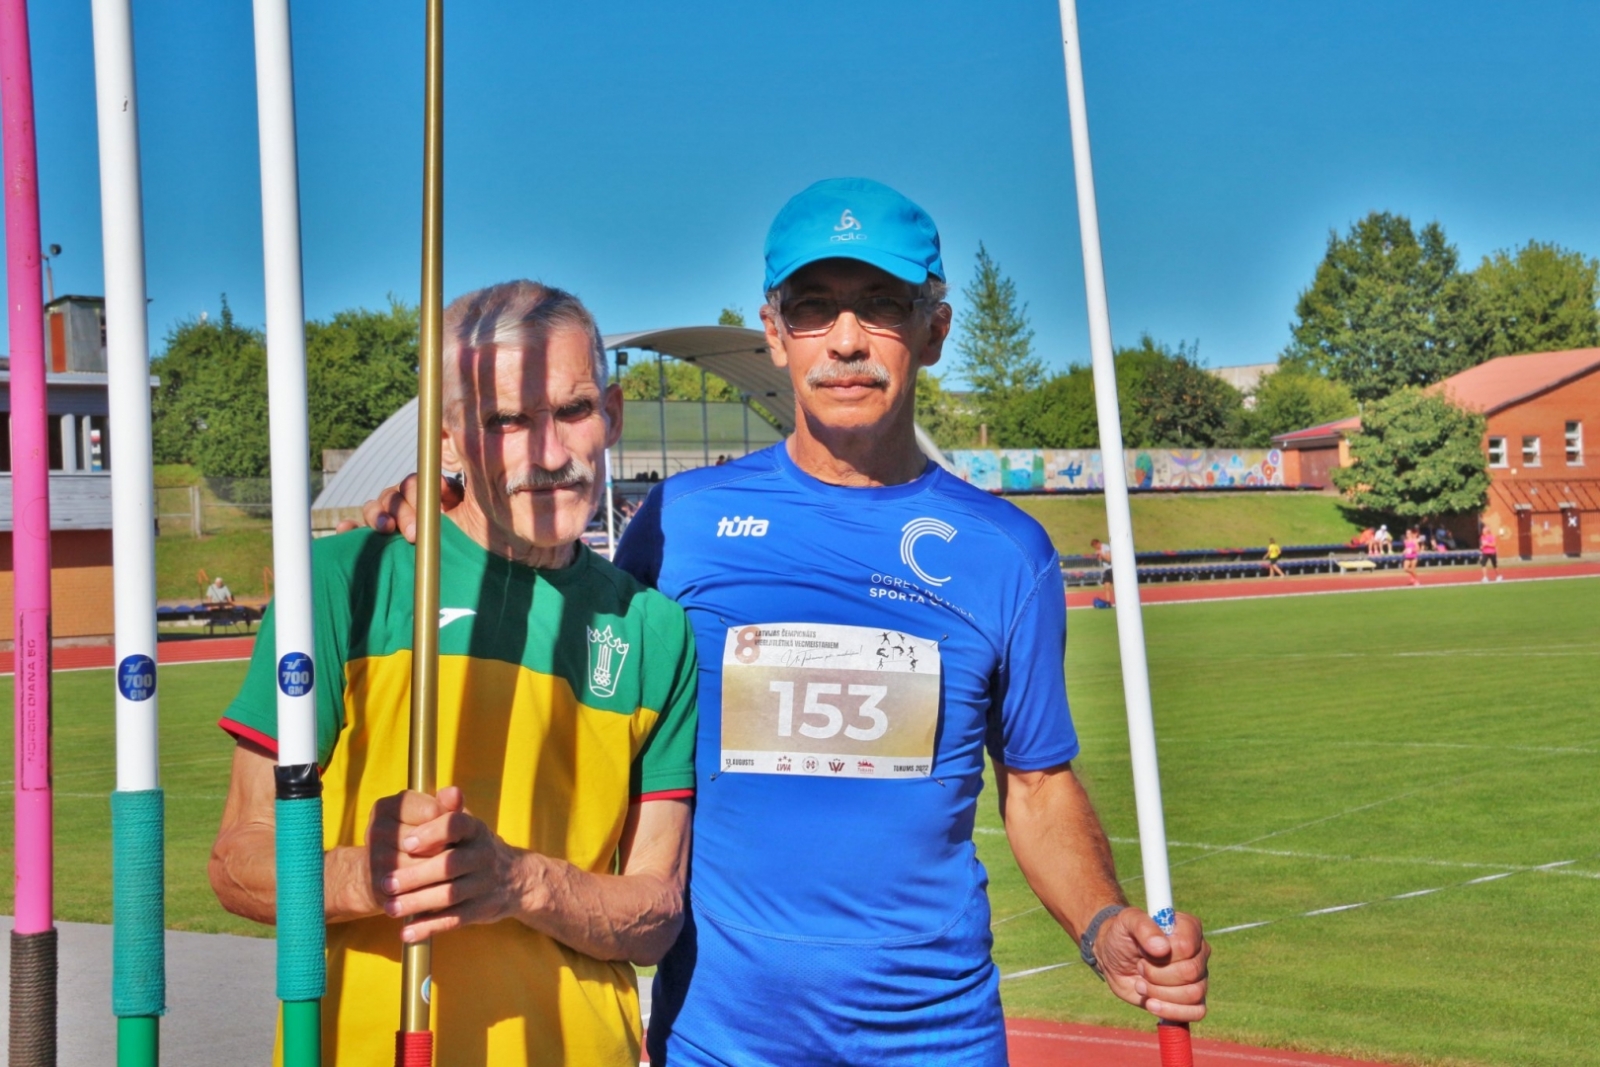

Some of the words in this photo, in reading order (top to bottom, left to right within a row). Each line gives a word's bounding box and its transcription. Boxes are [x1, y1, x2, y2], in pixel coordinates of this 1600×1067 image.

[869, 587, 925, 605] SPORTA
[734, 626, 761, 664] 8
[27, 661, 36, 707] DIANA
[124, 674, 152, 689] 700
[282, 671, 309, 685] 700
[130, 688, 147, 699] GM
[288, 685, 304, 695] GM
[769, 680, 889, 742] 153
[893, 764, 914, 772] TUKUMS
